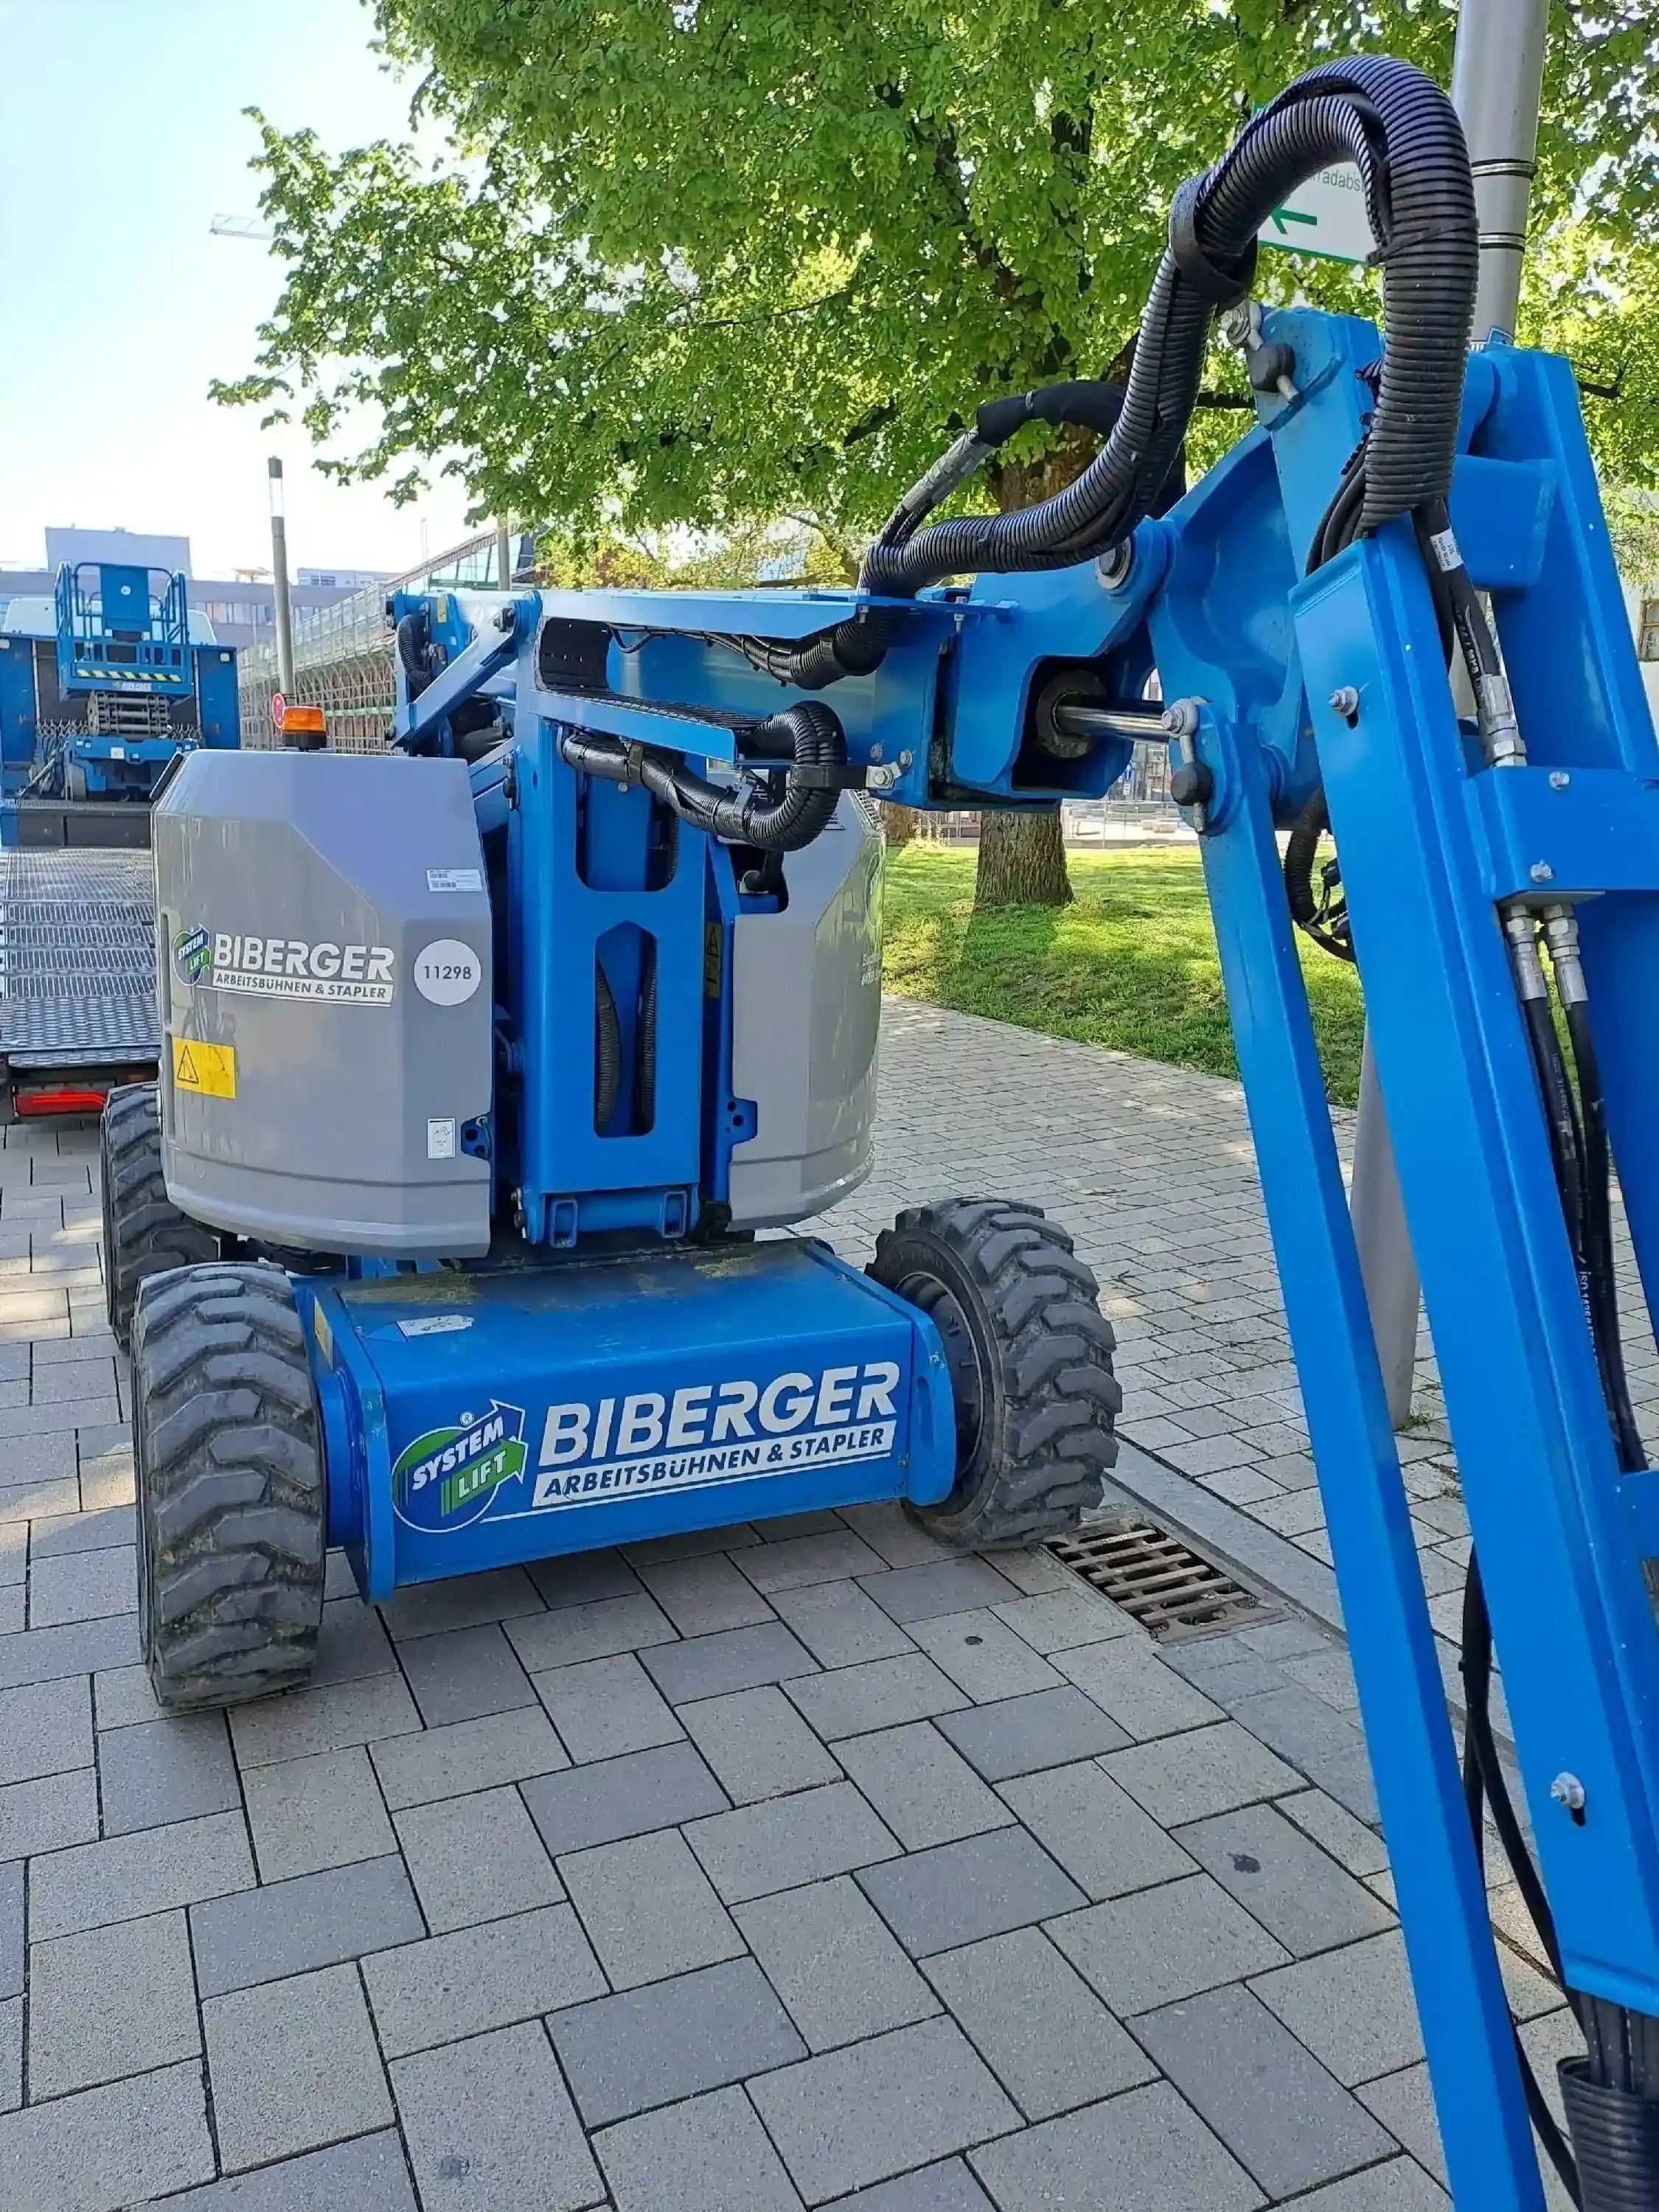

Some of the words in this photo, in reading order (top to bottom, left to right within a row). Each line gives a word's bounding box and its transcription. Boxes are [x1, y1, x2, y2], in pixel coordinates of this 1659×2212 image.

[178, 933, 204, 961] SYSTEM
[190, 952, 204, 970] LIFT
[214, 933, 394, 981] BIBERGER
[216, 973, 311, 994] ARBEITSBÜHNEN
[315, 984, 324, 995] &
[328, 984, 386, 998] STAPLER
[424, 965, 472, 980] 11298
[539, 1361, 900, 1467] BIBERGER
[412, 1416, 504, 1490] SYSTEM
[457, 1450, 507, 1499] LIFT
[543, 1447, 760, 1498] ARBEITSBÜHNEN
[767, 1443, 783, 1462] &
[790, 1427, 884, 1460] STAPLER
